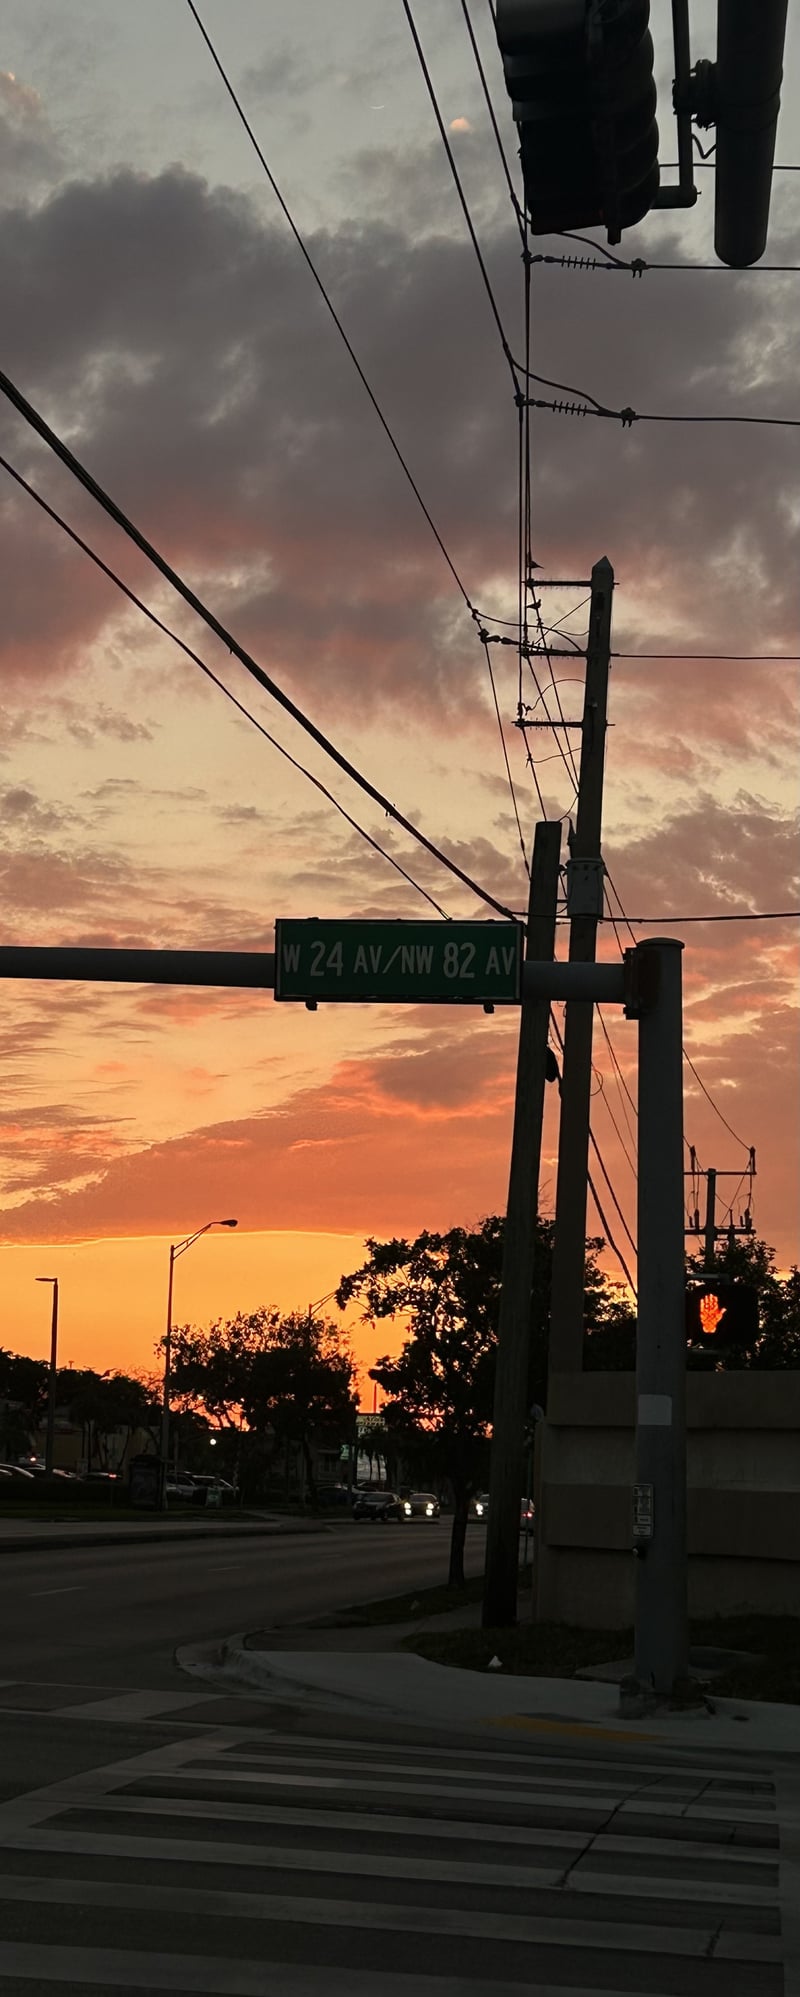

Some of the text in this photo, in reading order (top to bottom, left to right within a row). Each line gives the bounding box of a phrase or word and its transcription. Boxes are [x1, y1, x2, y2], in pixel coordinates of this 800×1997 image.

[283, 941, 515, 978] W 24 AV/NW 82 AV
